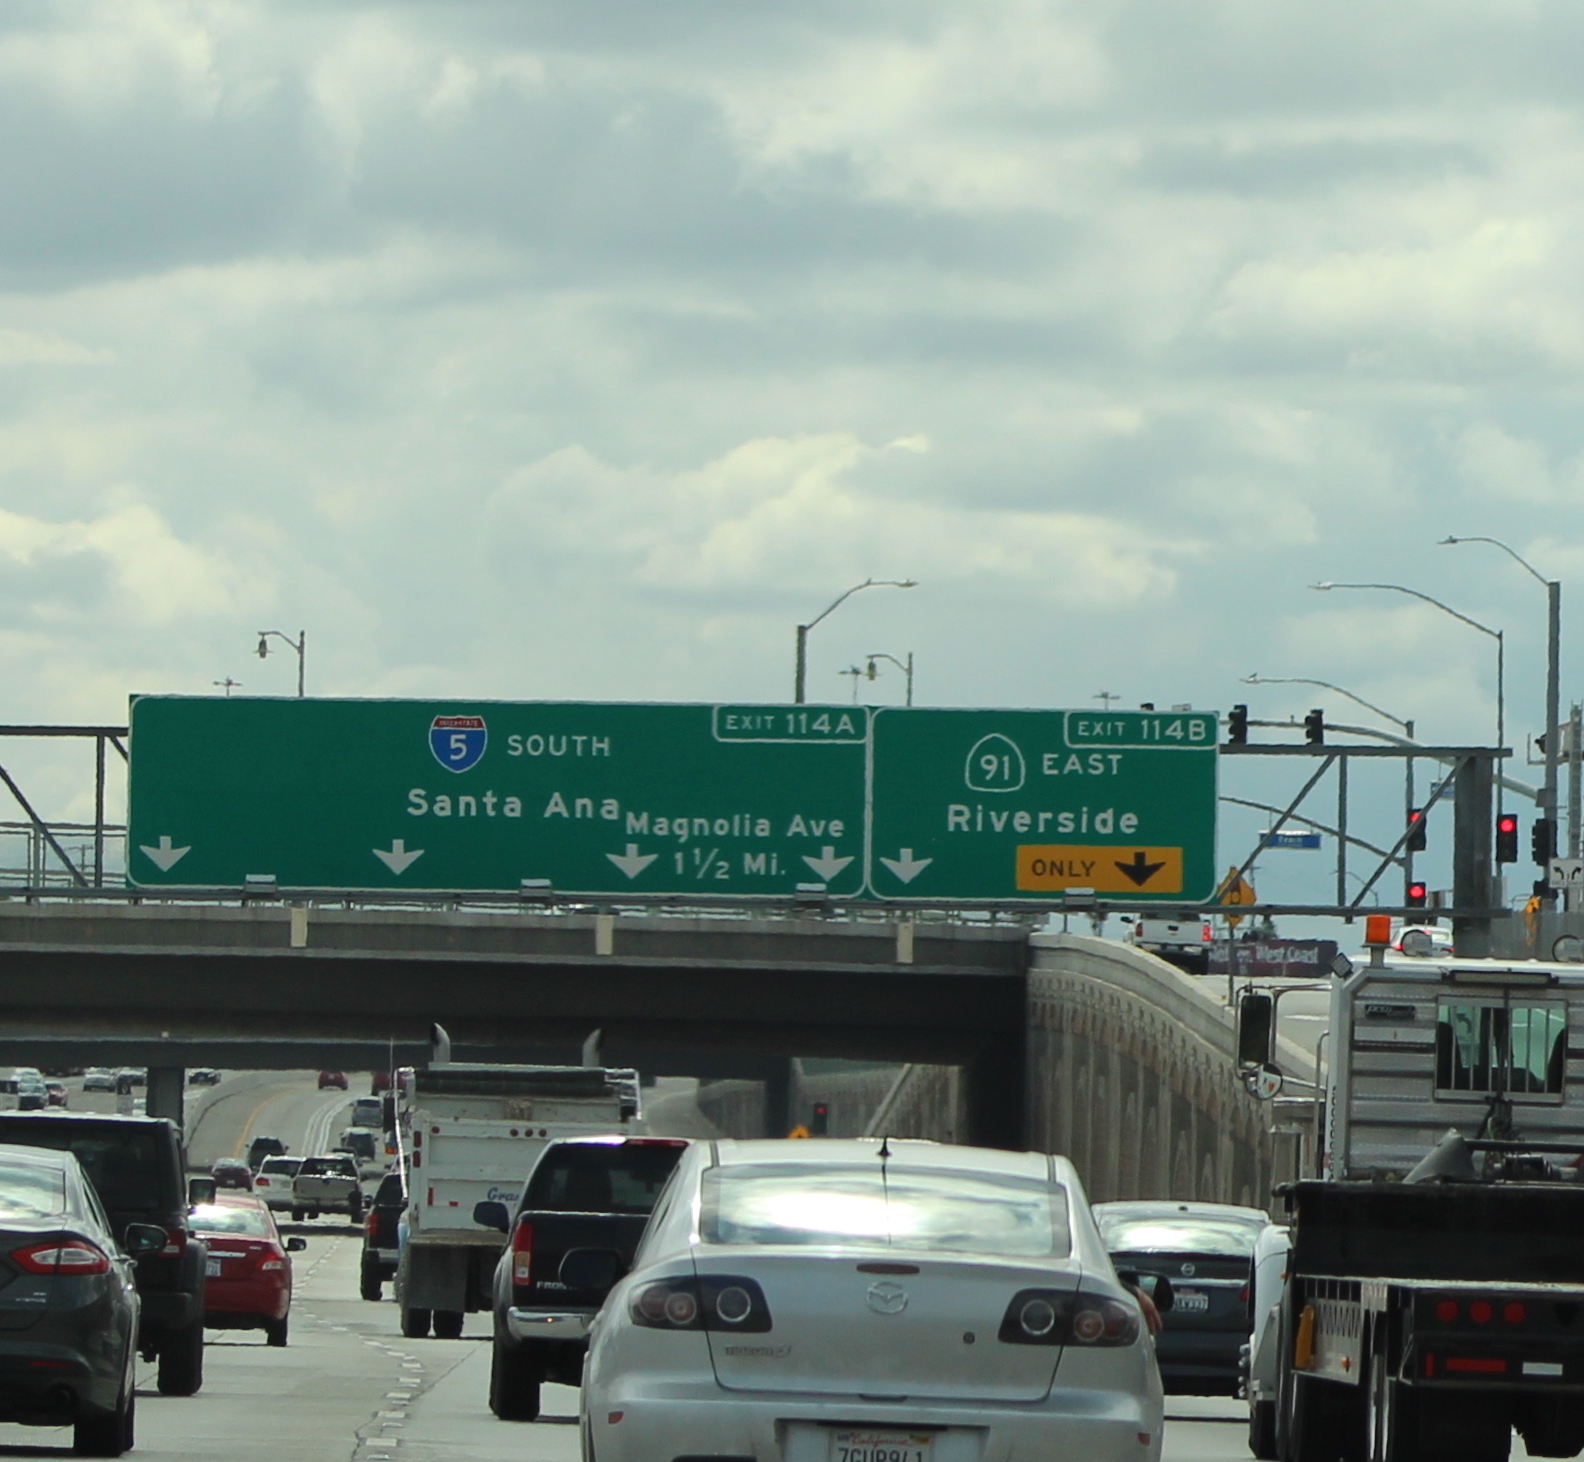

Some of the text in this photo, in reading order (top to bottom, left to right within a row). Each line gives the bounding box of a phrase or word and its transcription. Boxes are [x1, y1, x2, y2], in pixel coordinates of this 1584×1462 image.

[726, 714, 855, 735] EXIT 114A
[1078, 719, 1206, 742] EXIT 114B
[450, 734, 611, 761] 5 SOUTH
[980, 754, 1123, 781] 91 EAST
[407, 788, 620, 820] Santa Ana
[626, 811, 845, 843] Magnolia Ave
[948, 804, 1139, 834] Riverside
[744, 852, 786, 876] Mi.
[1031, 859, 1096, 878] ONLY
